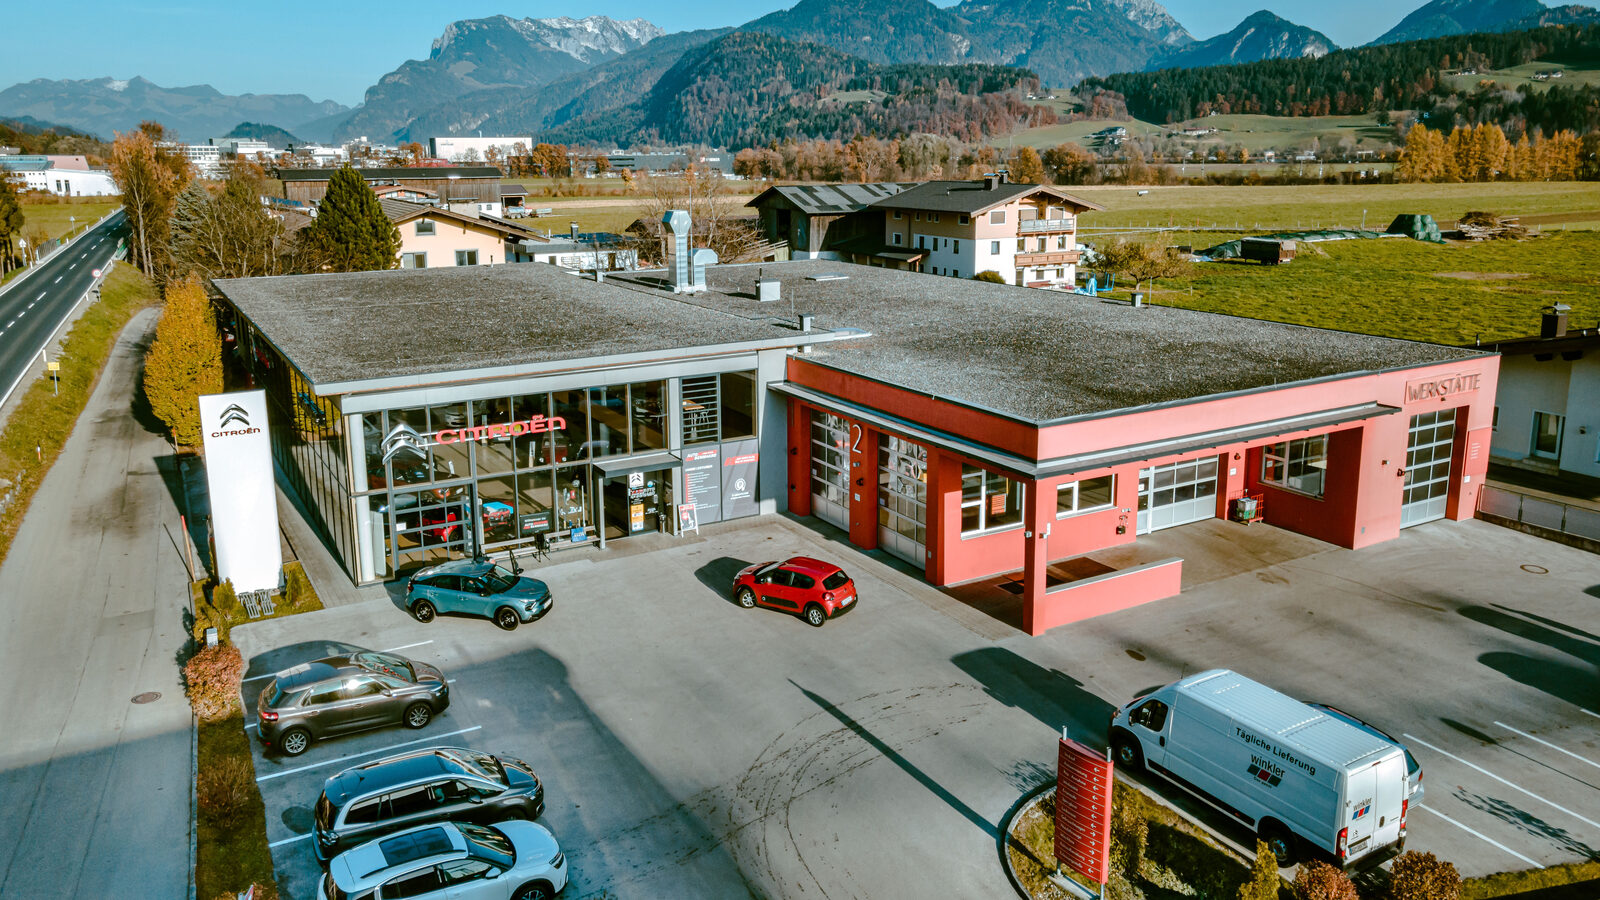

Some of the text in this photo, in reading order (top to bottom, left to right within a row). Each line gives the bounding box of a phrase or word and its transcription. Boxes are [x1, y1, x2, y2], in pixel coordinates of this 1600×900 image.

[1408, 373, 1482, 401] WERKSTÄTTE
[852, 424, 862, 454] 2
[1235, 727, 1316, 776] Tägliche Lieferung
[1250, 754, 1286, 778] winkler
[1353, 797, 1372, 811] winkler
